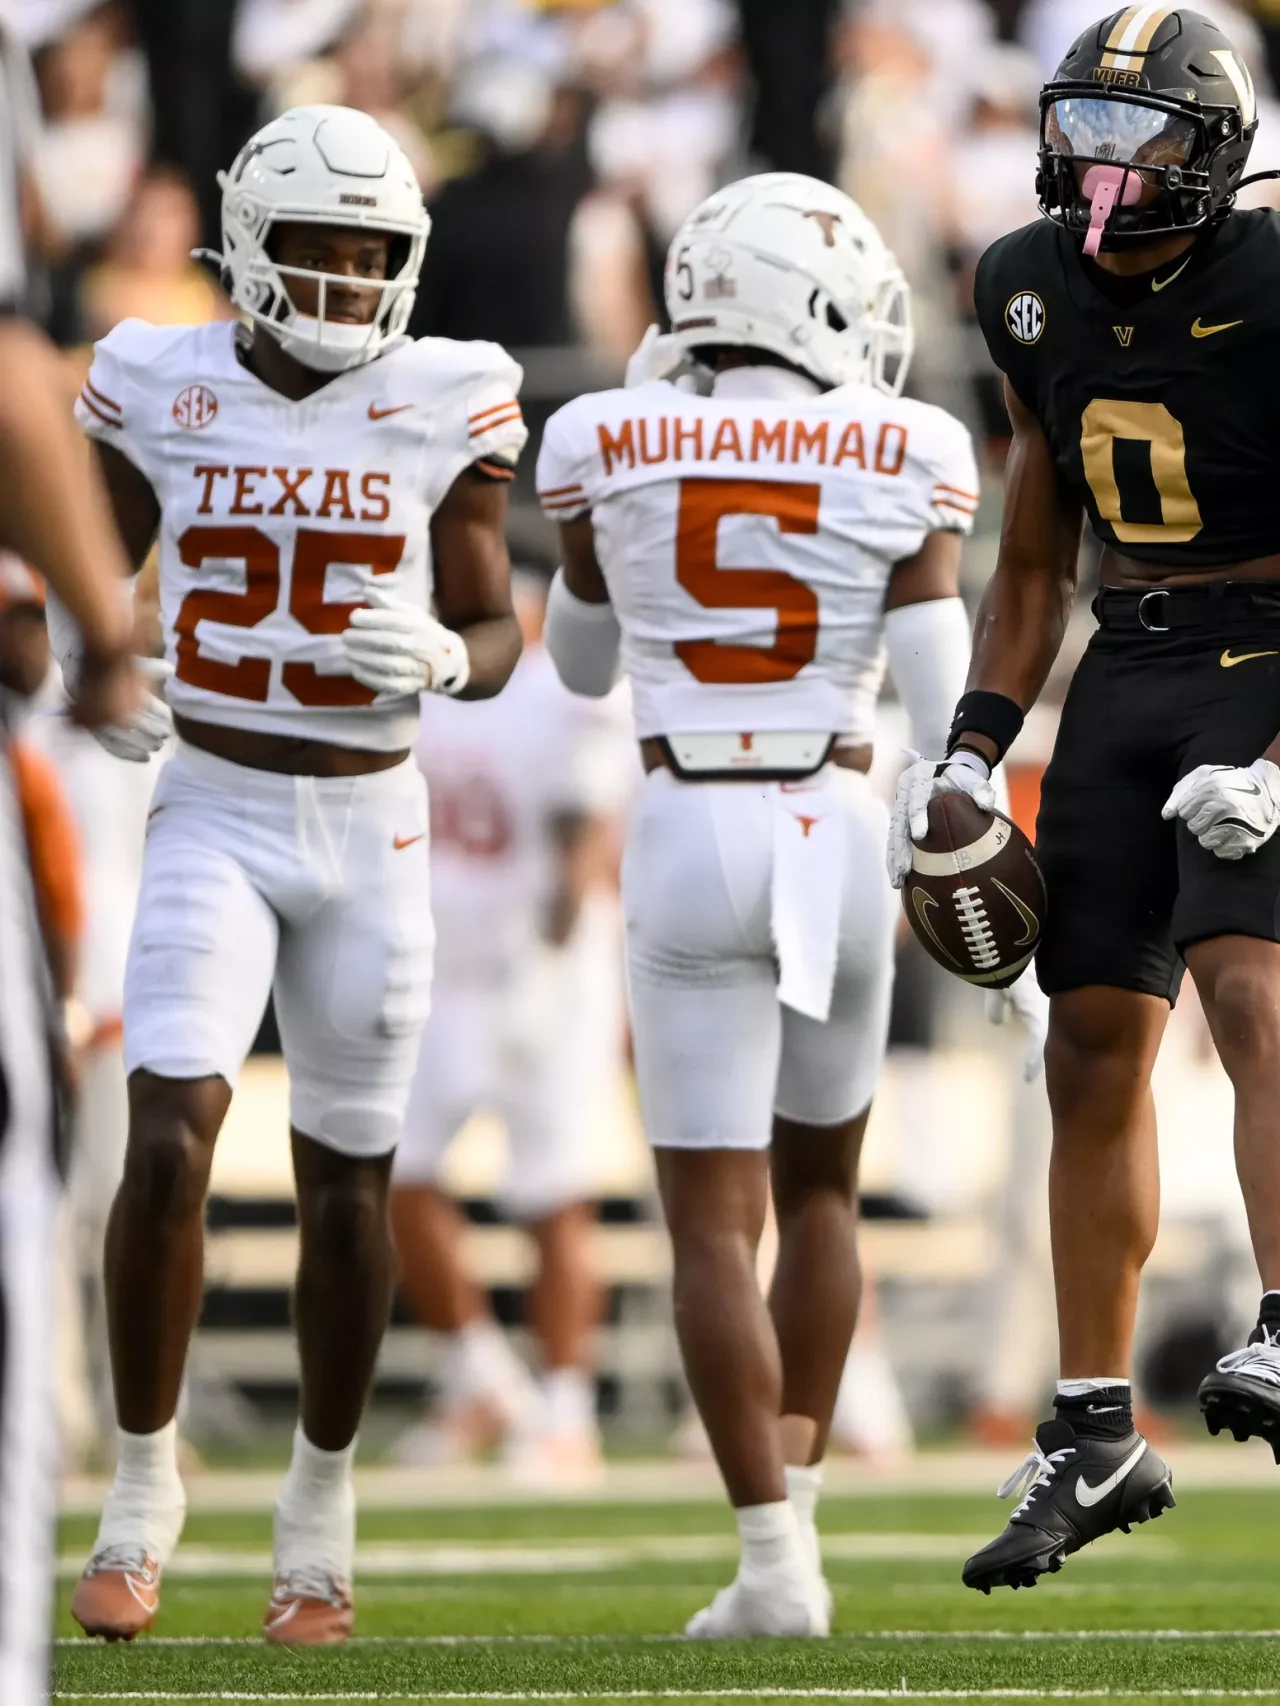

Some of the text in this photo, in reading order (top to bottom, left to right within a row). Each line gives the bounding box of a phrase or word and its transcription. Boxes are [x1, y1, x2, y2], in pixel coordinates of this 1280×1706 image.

[1009, 295, 1042, 340] SEC
[1112, 326, 1134, 346] V
[173, 385, 217, 429] SEC
[597, 416, 908, 477] MUHAMMAD
[1080, 399, 1204, 543] 0
[194, 465, 390, 522] TEXAS
[674, 476, 821, 684] 5
[173, 525, 406, 707] 25
